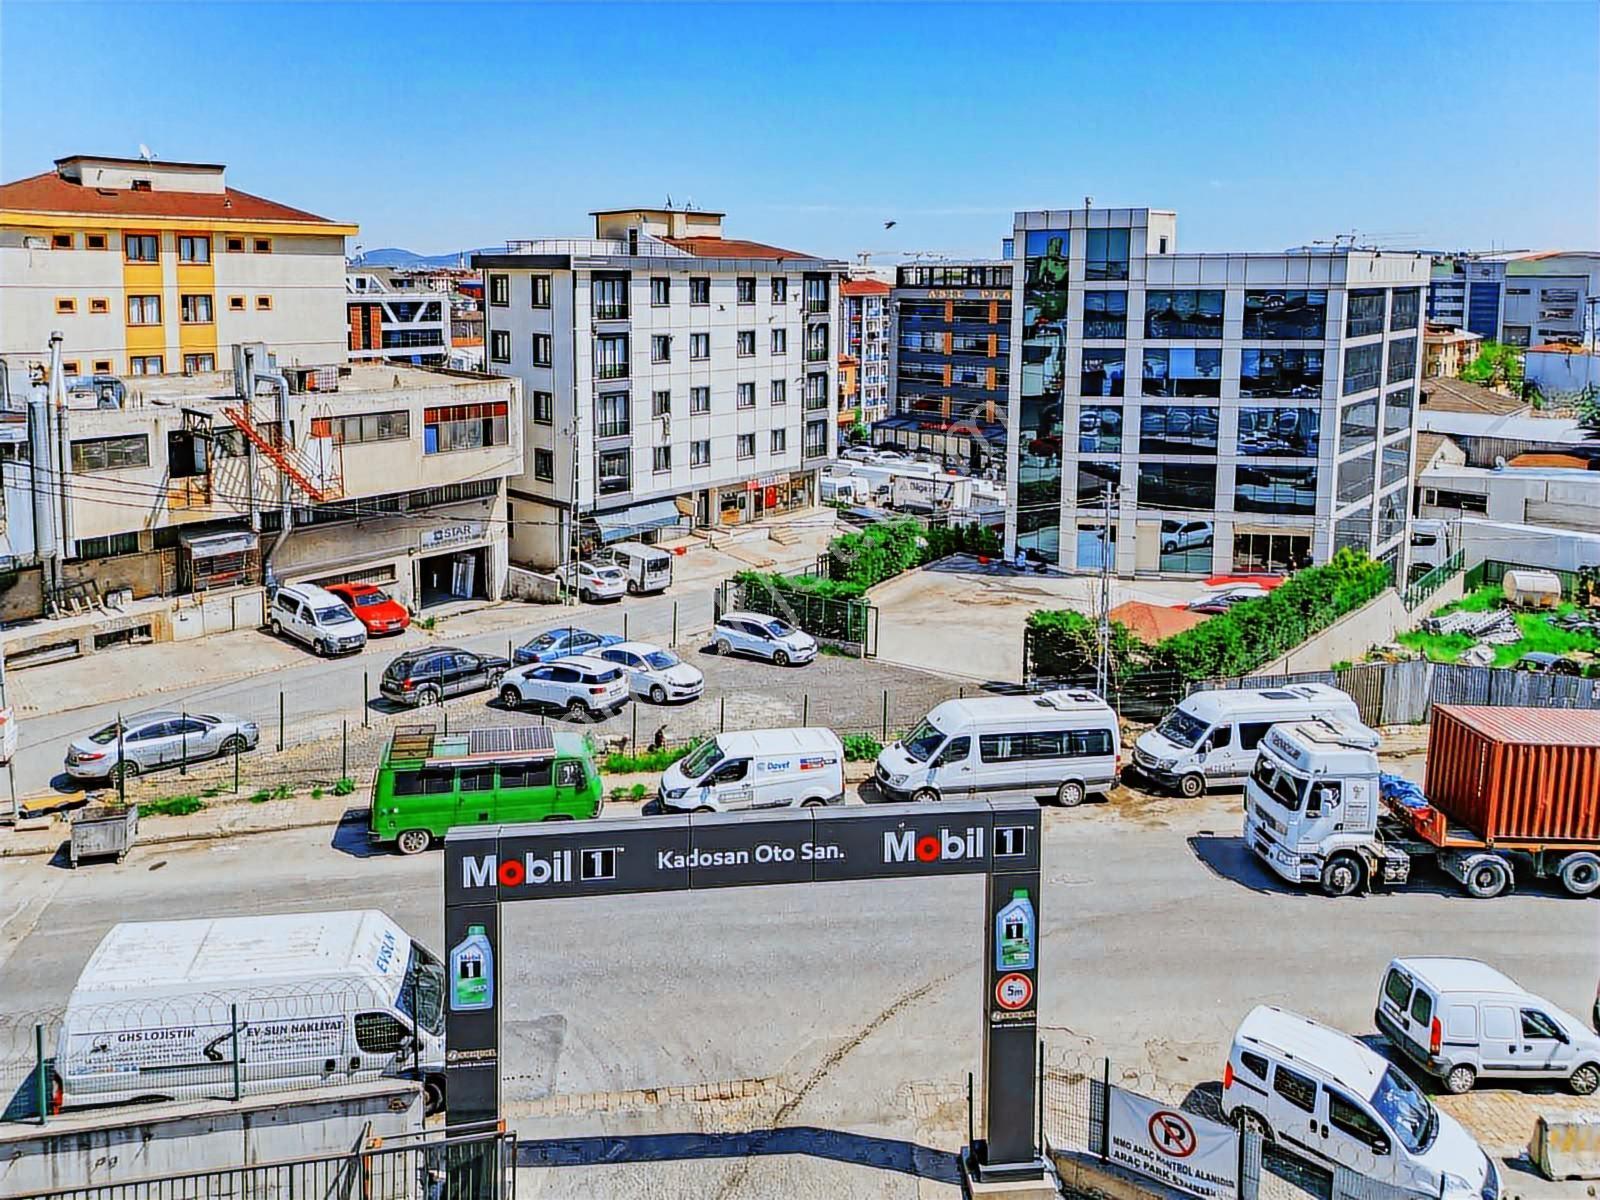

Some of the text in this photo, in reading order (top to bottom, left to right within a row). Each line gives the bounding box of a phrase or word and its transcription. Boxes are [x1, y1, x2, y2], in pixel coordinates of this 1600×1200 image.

[444, 525, 471, 538] STAR
[657, 842, 845, 870] Kadosan Oto San.
[884, 827, 984, 863] Mobil
[462, 850, 572, 888] Mobil
[1007, 985, 1024, 997] 5m
[118, 1028, 196, 1043] GHS LOJİSTİK
[1113, 1150, 1170, 1180] ARAÇ PARK
[1133, 1145, 1155, 1160] ARAÇ
[1156, 1153, 1193, 1177] KONTROL
